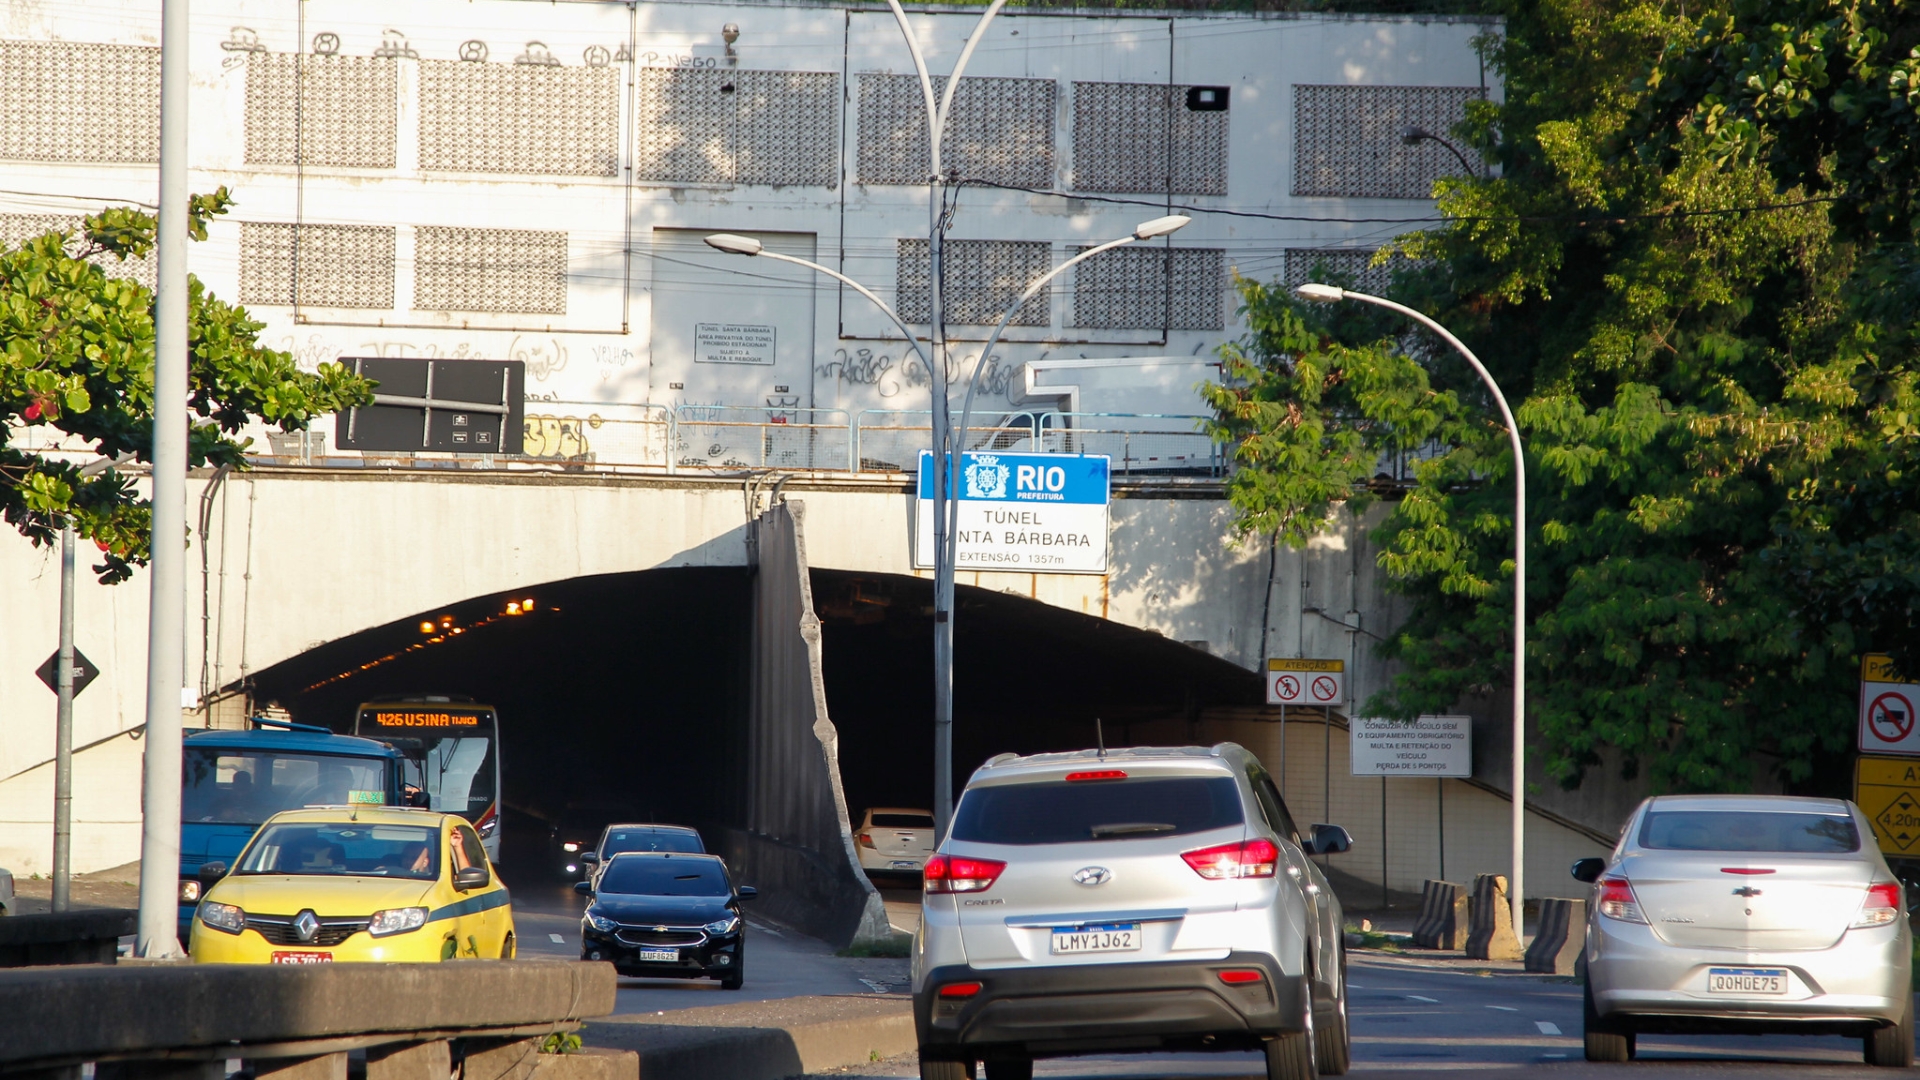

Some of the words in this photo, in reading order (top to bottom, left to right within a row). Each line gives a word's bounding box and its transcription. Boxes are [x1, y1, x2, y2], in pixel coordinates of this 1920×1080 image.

[1016, 465, 1066, 492] RIO
[1016, 492, 1064, 500] PREFEITURA
[983, 507, 1042, 525] TÚNEL
[946, 530, 993, 544] NTA
[1005, 528, 1090, 547] BÁRBARA
[959, 551, 1021, 563] EXTENSÃO
[1028, 554, 1064, 564] 1357m
[1285, 661, 1327, 670] ATENÇÃO
[376, 713, 404, 726] 426
[405, 713, 449, 726] USINA
[451, 716, 478, 725] TIJUCA
[1365, 722, 1401, 730] CONDUZIR
[1418, 732, 1464, 740] OBRIGATÓRIO
[1401, 742, 1439, 750] RETENÇÃO
[350, 791, 384, 804] TAXI
[964, 898, 1005, 906] CRETA
[1060, 932, 1131, 950] LMY1J62
